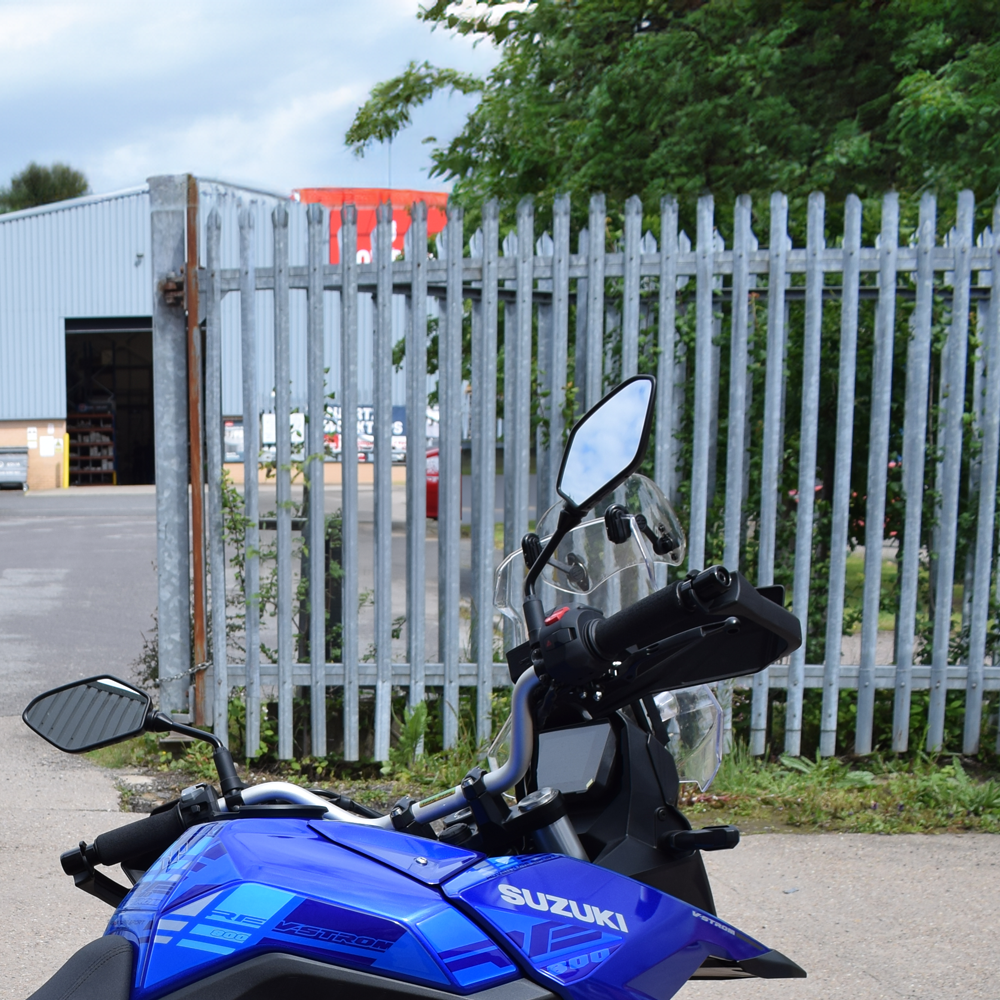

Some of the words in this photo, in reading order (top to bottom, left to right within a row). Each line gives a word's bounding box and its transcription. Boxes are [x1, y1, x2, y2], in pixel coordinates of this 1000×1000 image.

[210, 909, 267, 925] RE
[498, 884, 629, 933] SUZUKI
[210, 929, 250, 941] 800
[274, 920, 395, 950] V-STROM
[691, 910, 736, 936] V-STROM
[547, 947, 610, 975] 800
